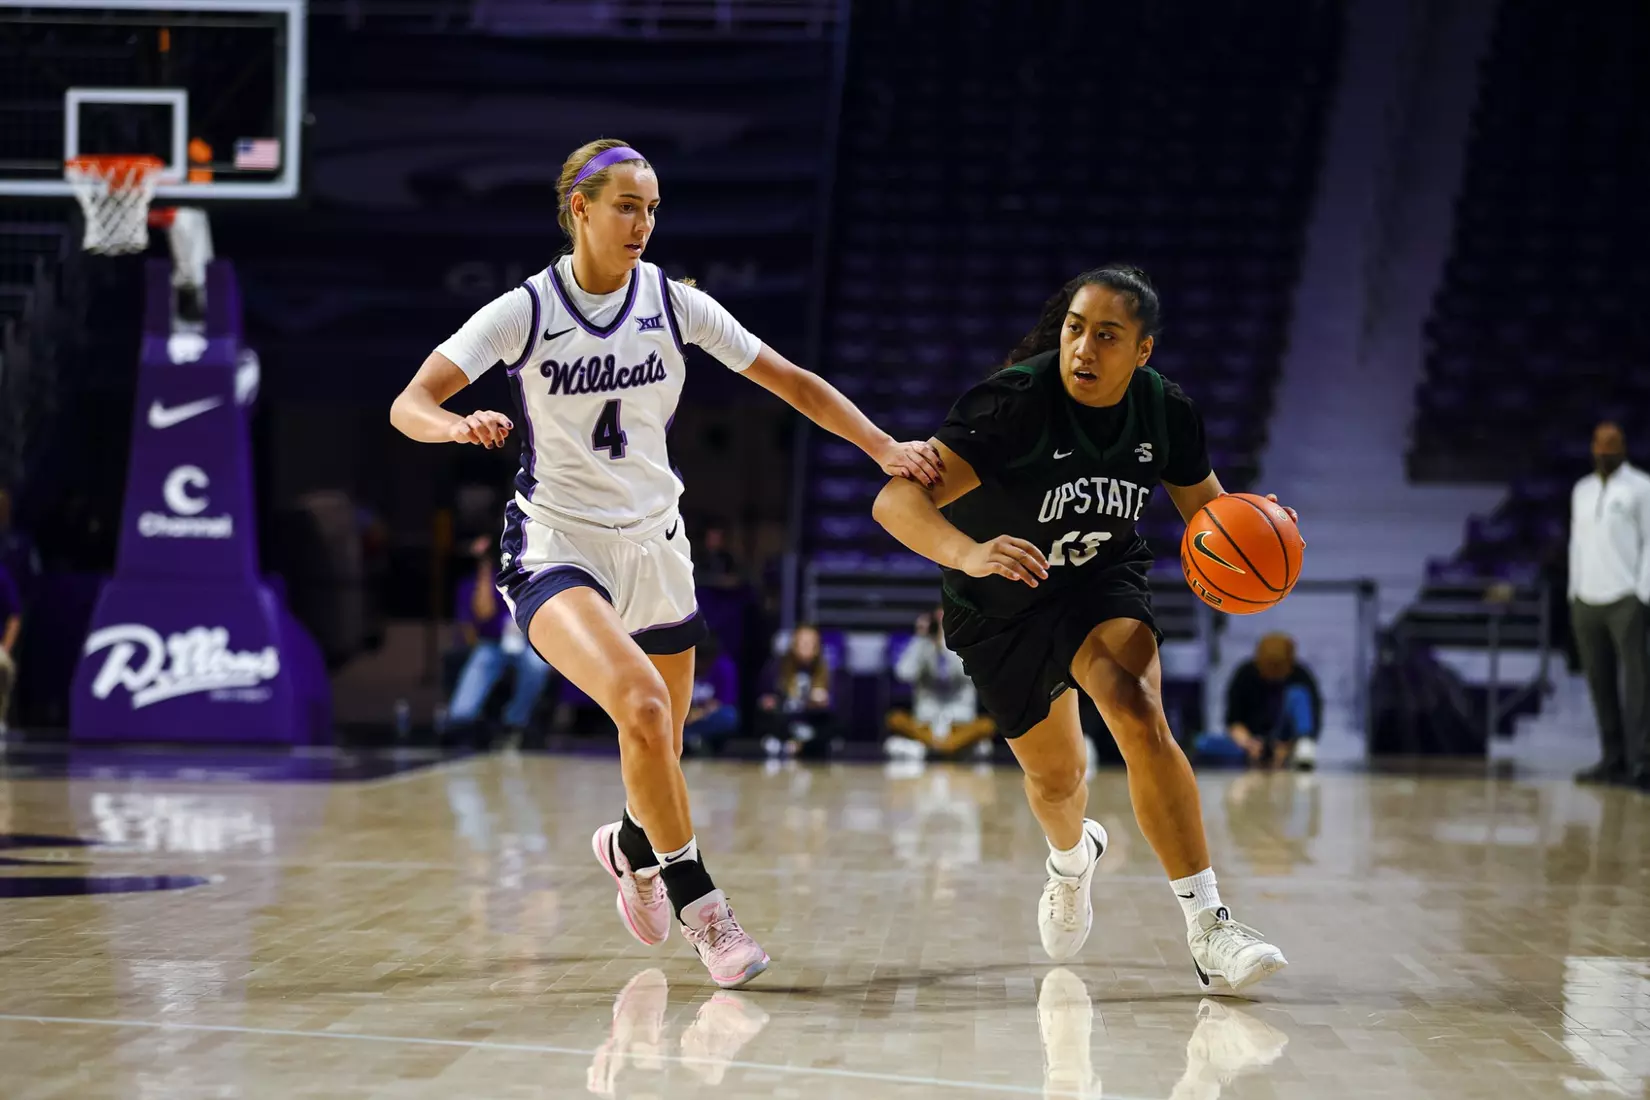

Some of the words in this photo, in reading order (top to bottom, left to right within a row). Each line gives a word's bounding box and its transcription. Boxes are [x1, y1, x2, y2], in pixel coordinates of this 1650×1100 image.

[540, 350, 667, 395] Wildcats
[591, 398, 628, 460] 4
[1037, 476, 1150, 523] UPSTATE
